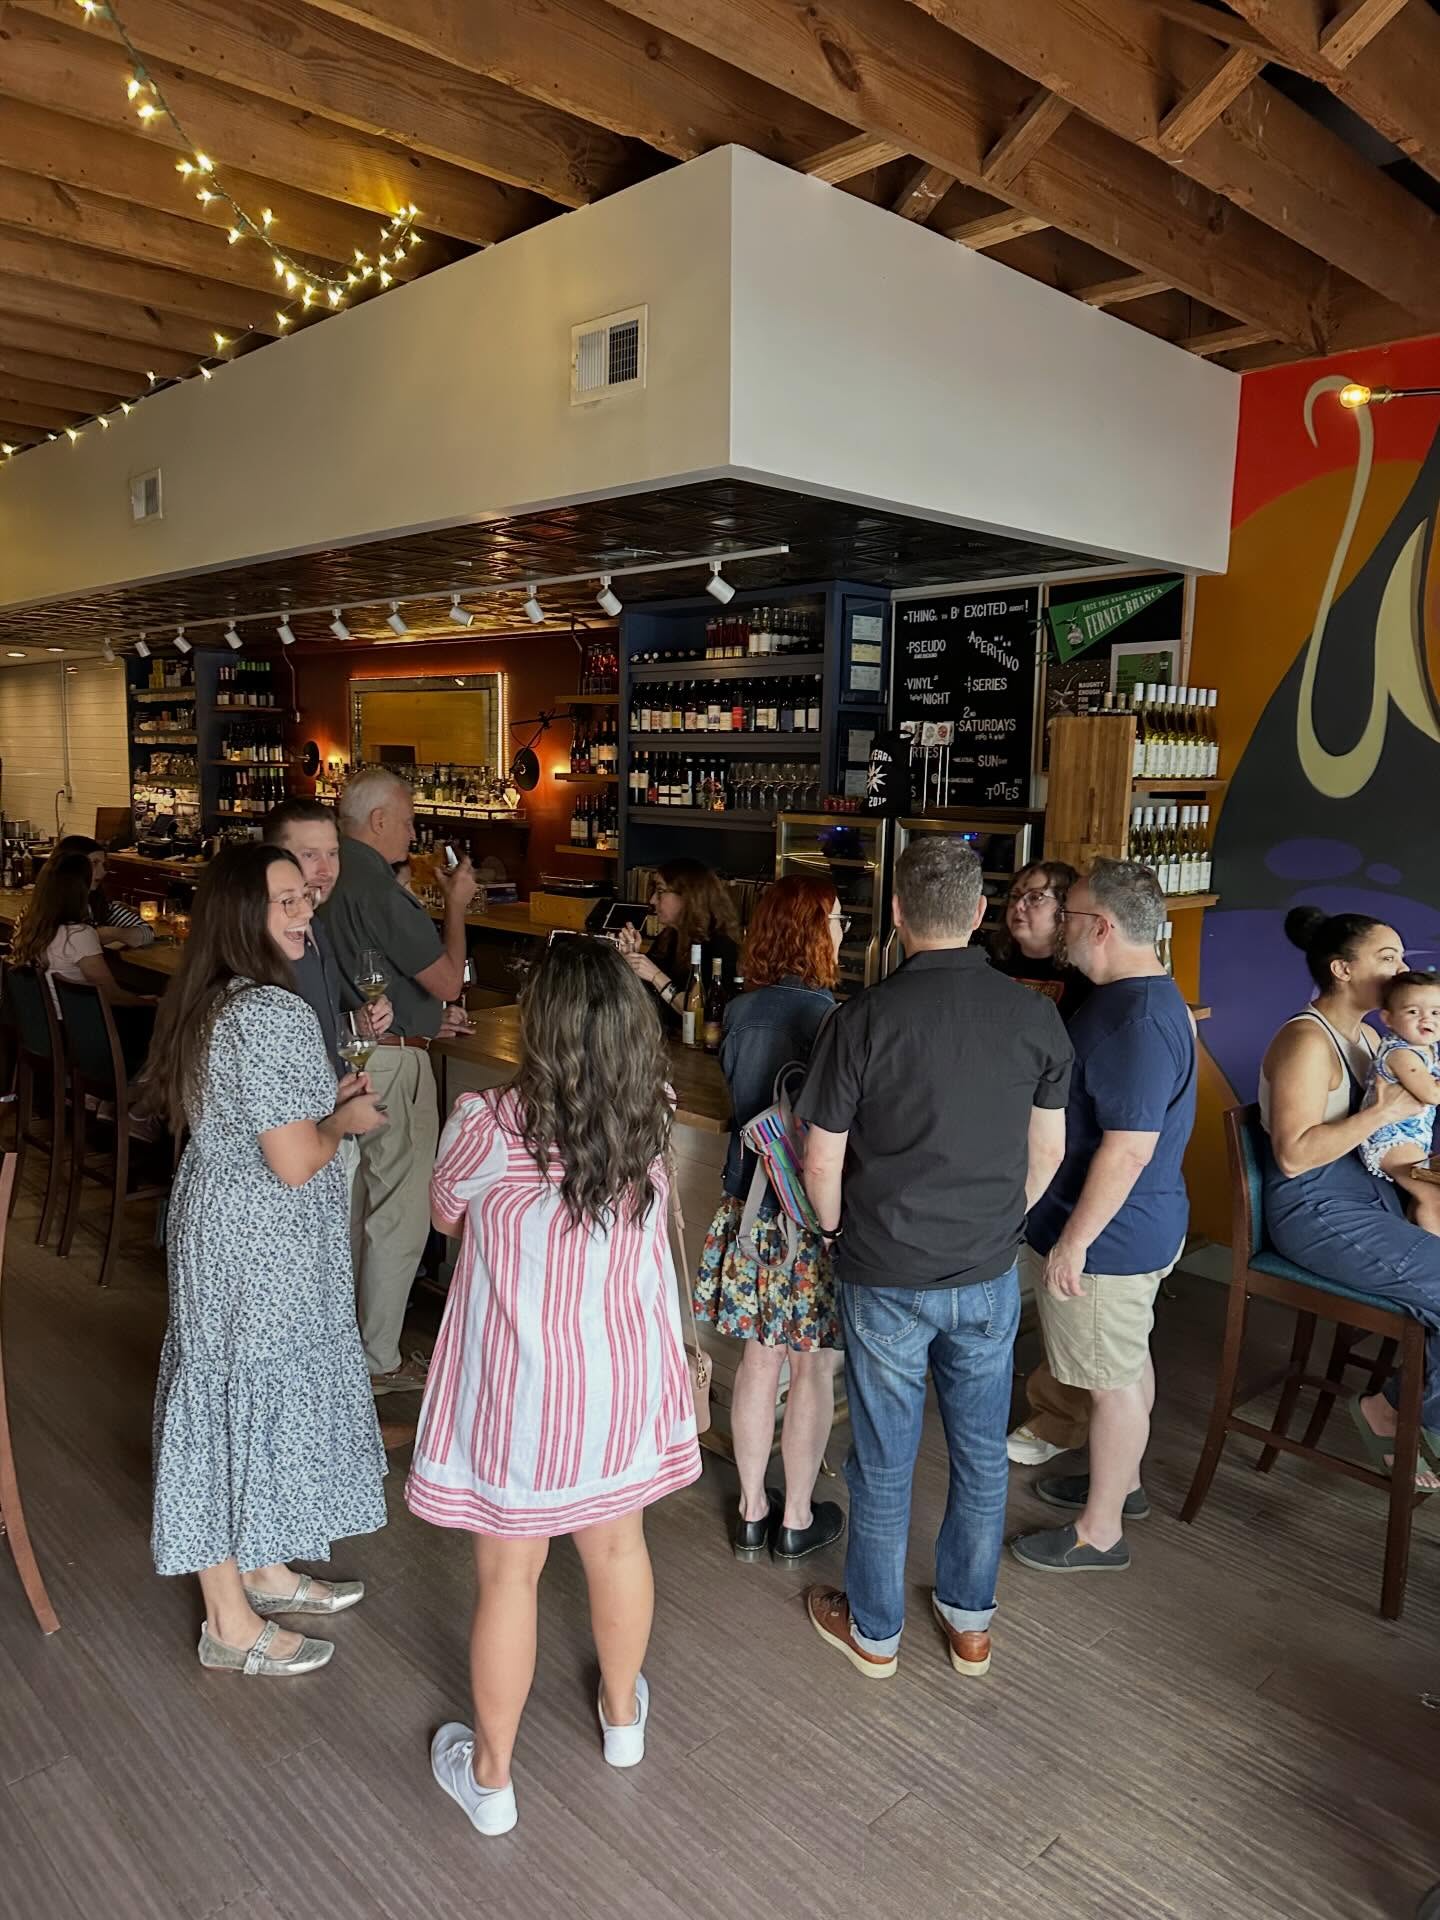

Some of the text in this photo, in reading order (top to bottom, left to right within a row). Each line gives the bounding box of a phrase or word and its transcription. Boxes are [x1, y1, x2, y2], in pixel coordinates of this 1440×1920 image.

[964, 601, 1007, 618] EXCITED
[1084, 588, 1163, 639] FERNET-BRANCA
[908, 639, 947, 654] PSEUDO
[967, 630, 1020, 672] APERITIVO
[906, 677, 935, 690] VINYL
[972, 677, 1008, 692] SERIES
[922, 692, 951, 705] NIGHT
[958, 719, 1017, 733] SATURDAYS
[986, 782, 1020, 801] TOTES
